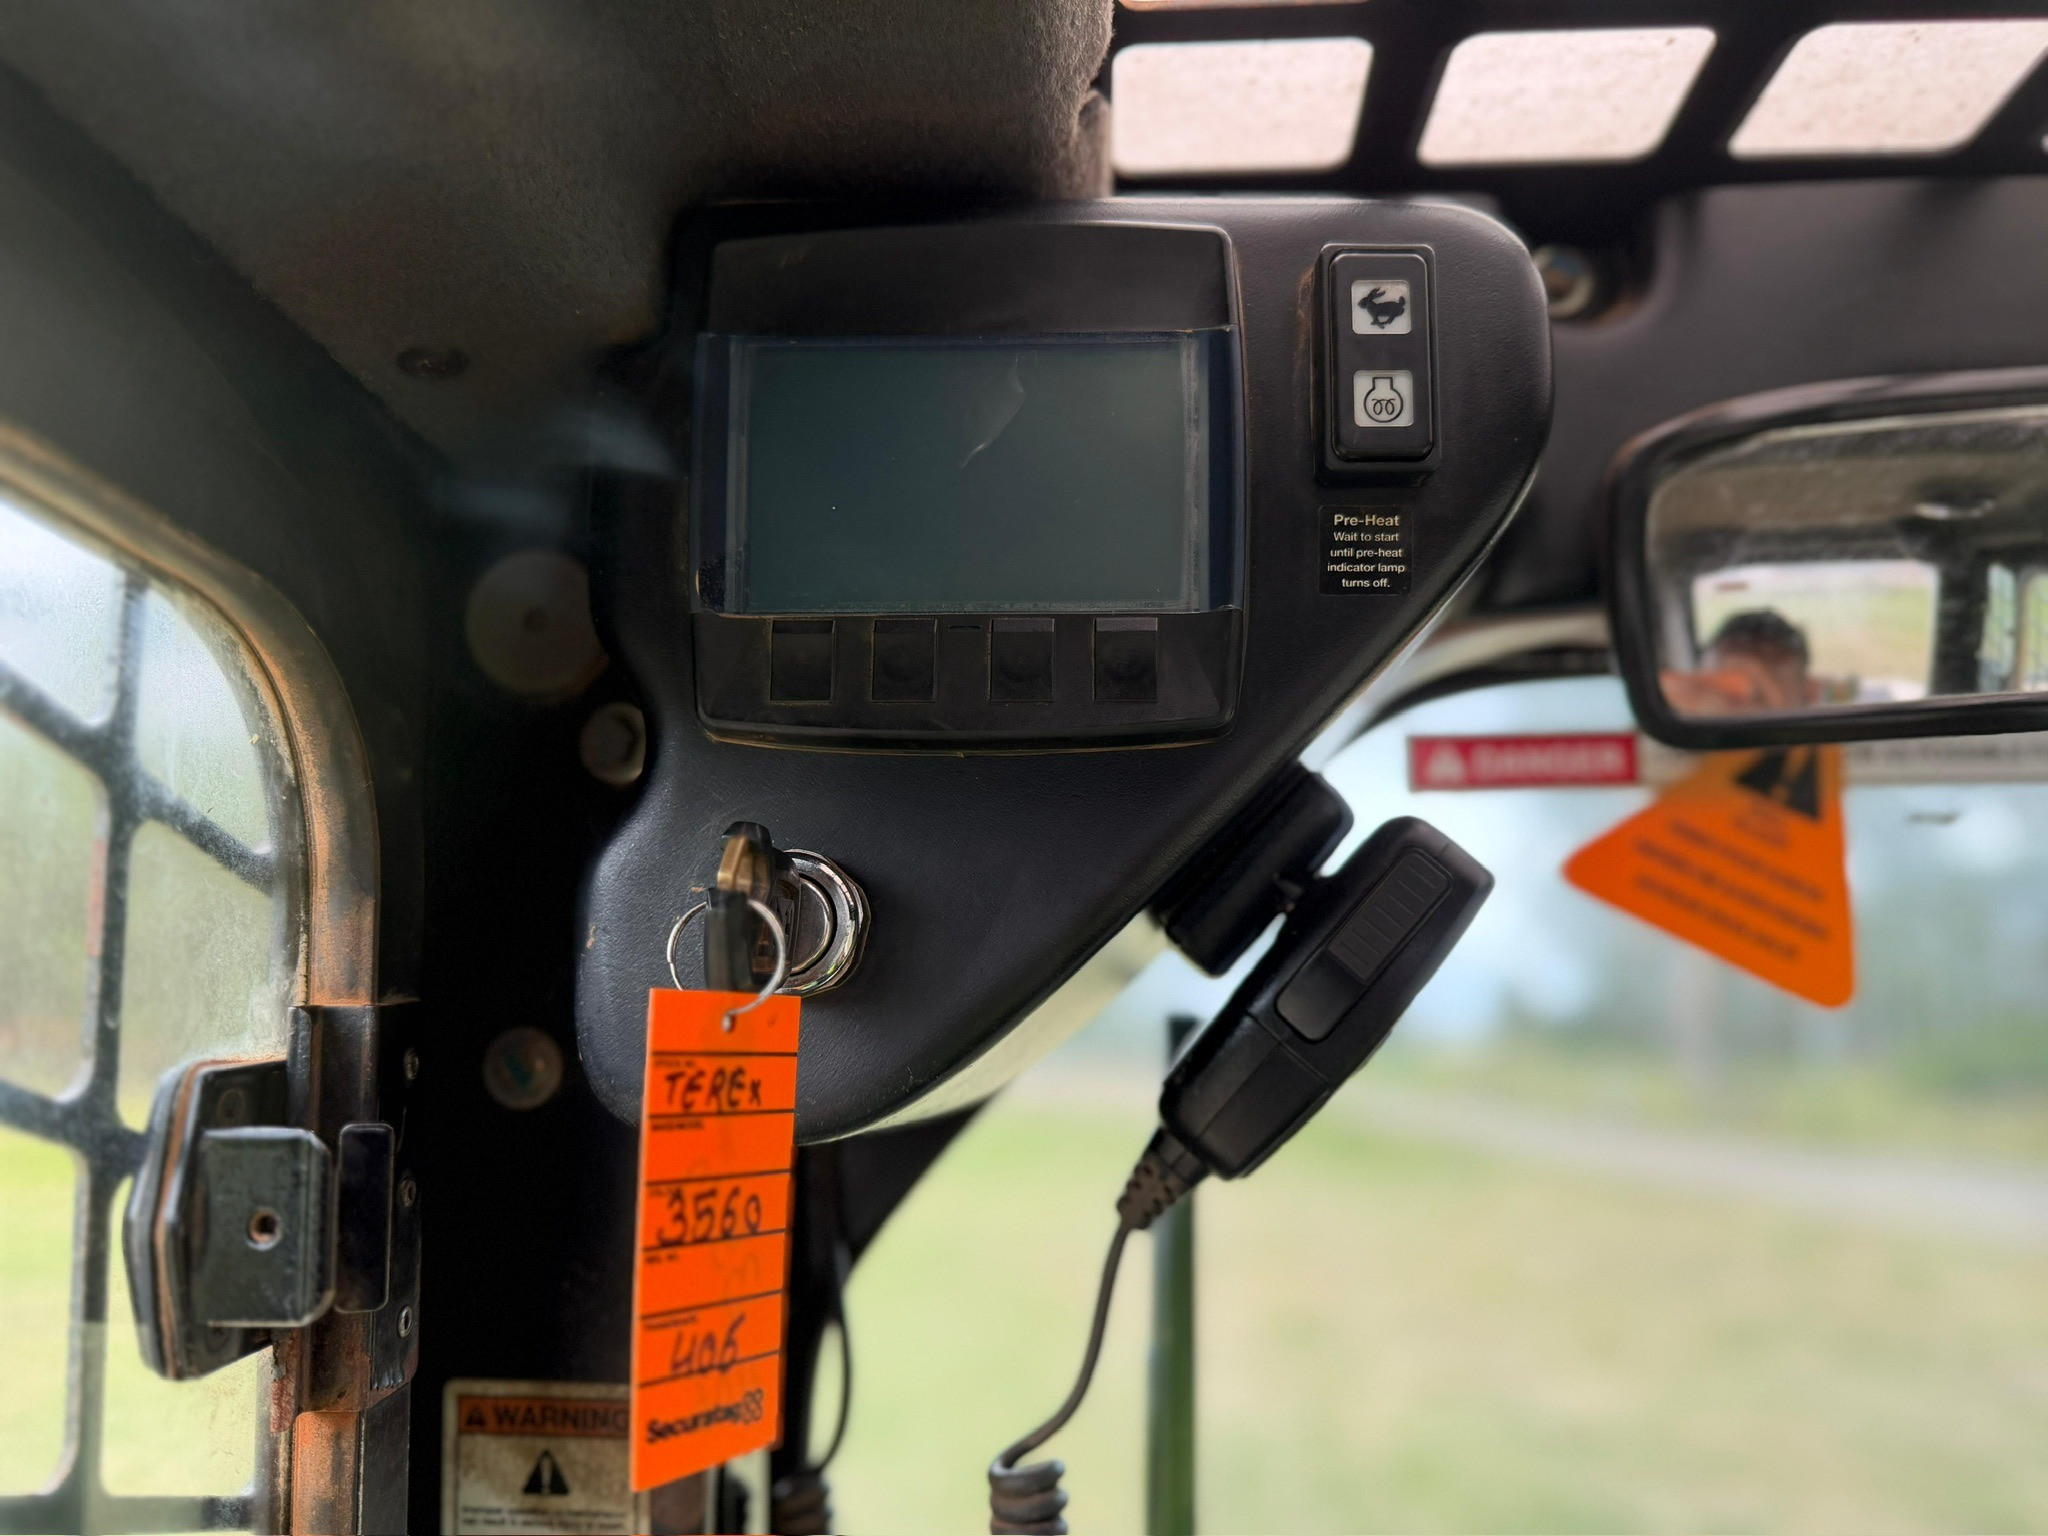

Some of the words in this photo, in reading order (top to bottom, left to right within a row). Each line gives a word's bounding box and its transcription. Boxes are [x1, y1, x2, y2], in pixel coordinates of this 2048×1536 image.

[1333, 514, 1400, 526] Pre-Heat
[1333, 532, 1358, 541] Wait
[1360, 533, 1372, 541] to
[1374, 532, 1399, 541] start
[1330, 548, 1353, 557] until
[1355, 548, 1403, 559] pre-heat
[1327, 562, 1375, 572] indicator
[1377, 563, 1406, 574] lamp
[1341, 578, 1370, 588] turns
[1372, 578, 1391, 588] off.
[656, 1186, 762, 1247] 3560
